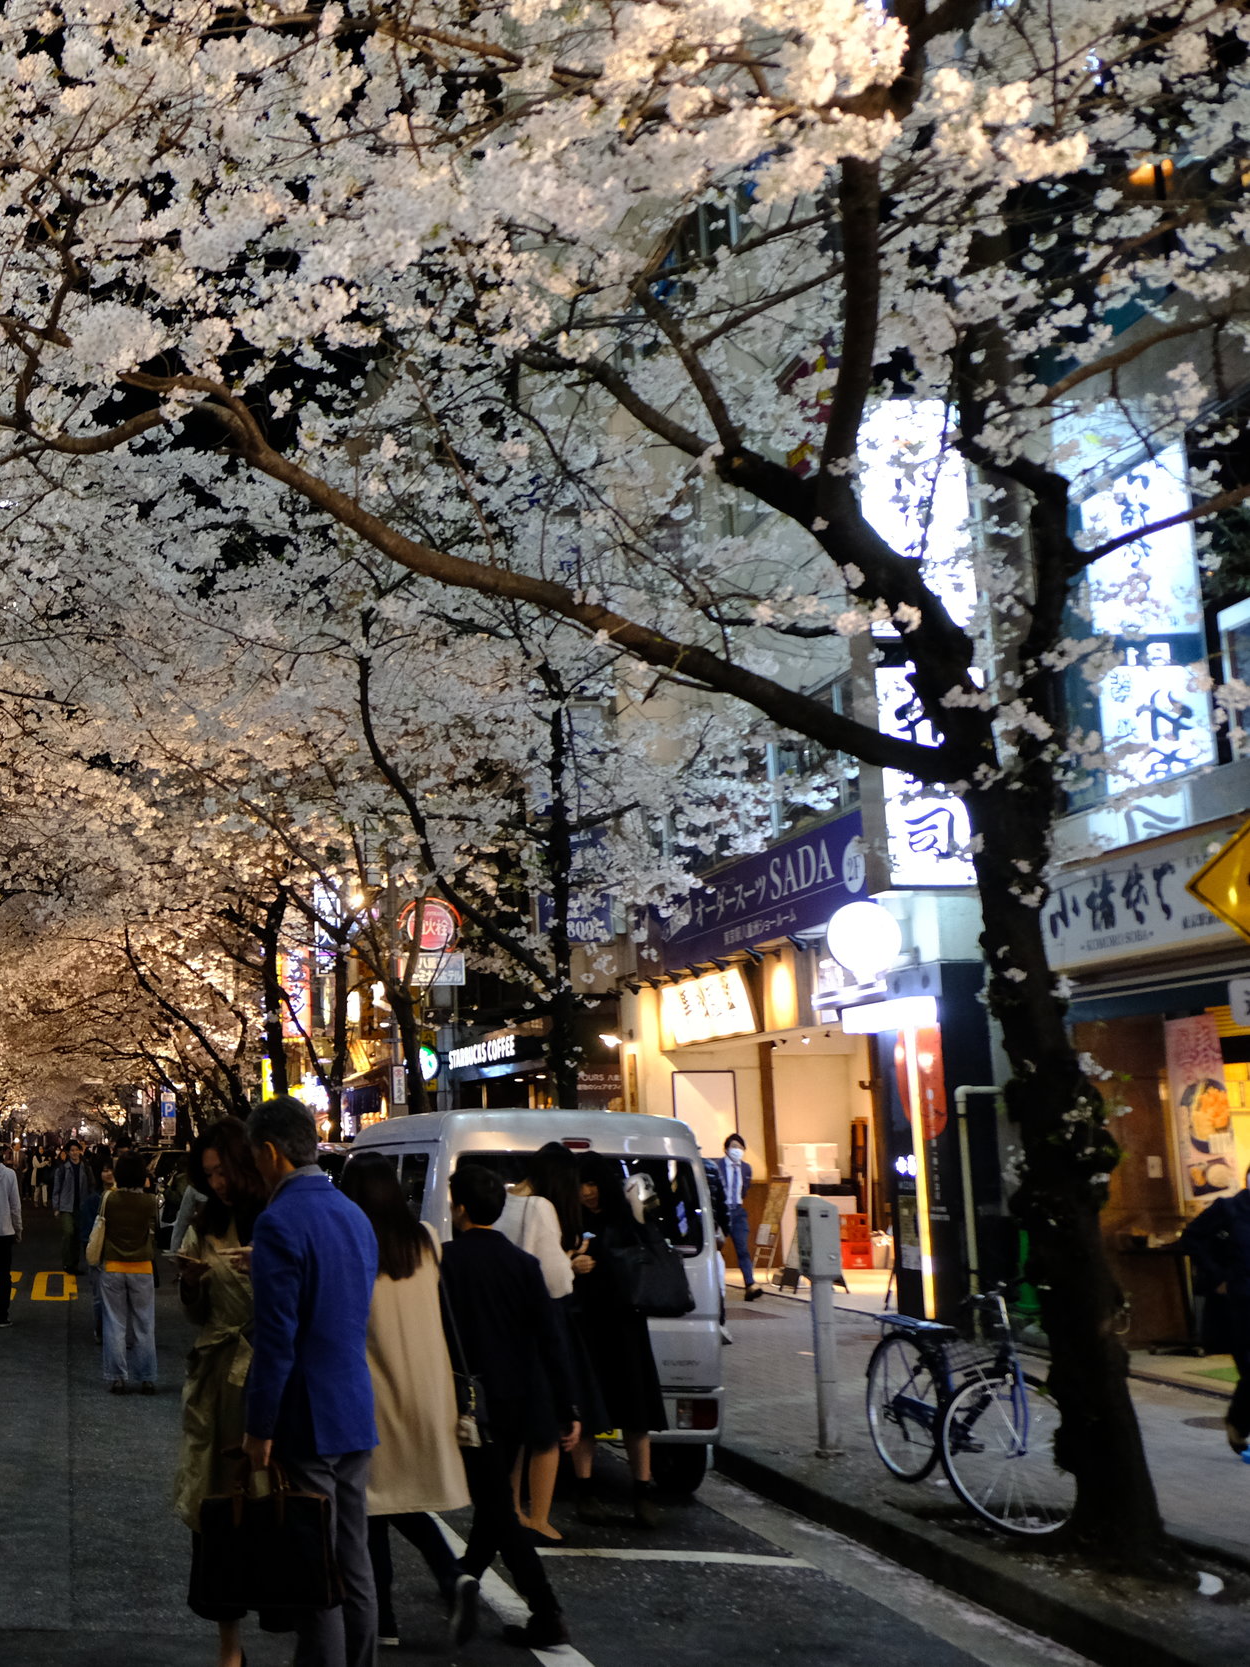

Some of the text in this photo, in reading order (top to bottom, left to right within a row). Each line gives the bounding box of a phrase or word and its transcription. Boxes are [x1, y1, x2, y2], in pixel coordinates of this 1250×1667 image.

[769, 839, 835, 900] SADA
[449, 1042, 486, 1070] STARBUCKS
[487, 1035, 515, 1060] COFFEE
[165, 1103, 173, 1117] P
